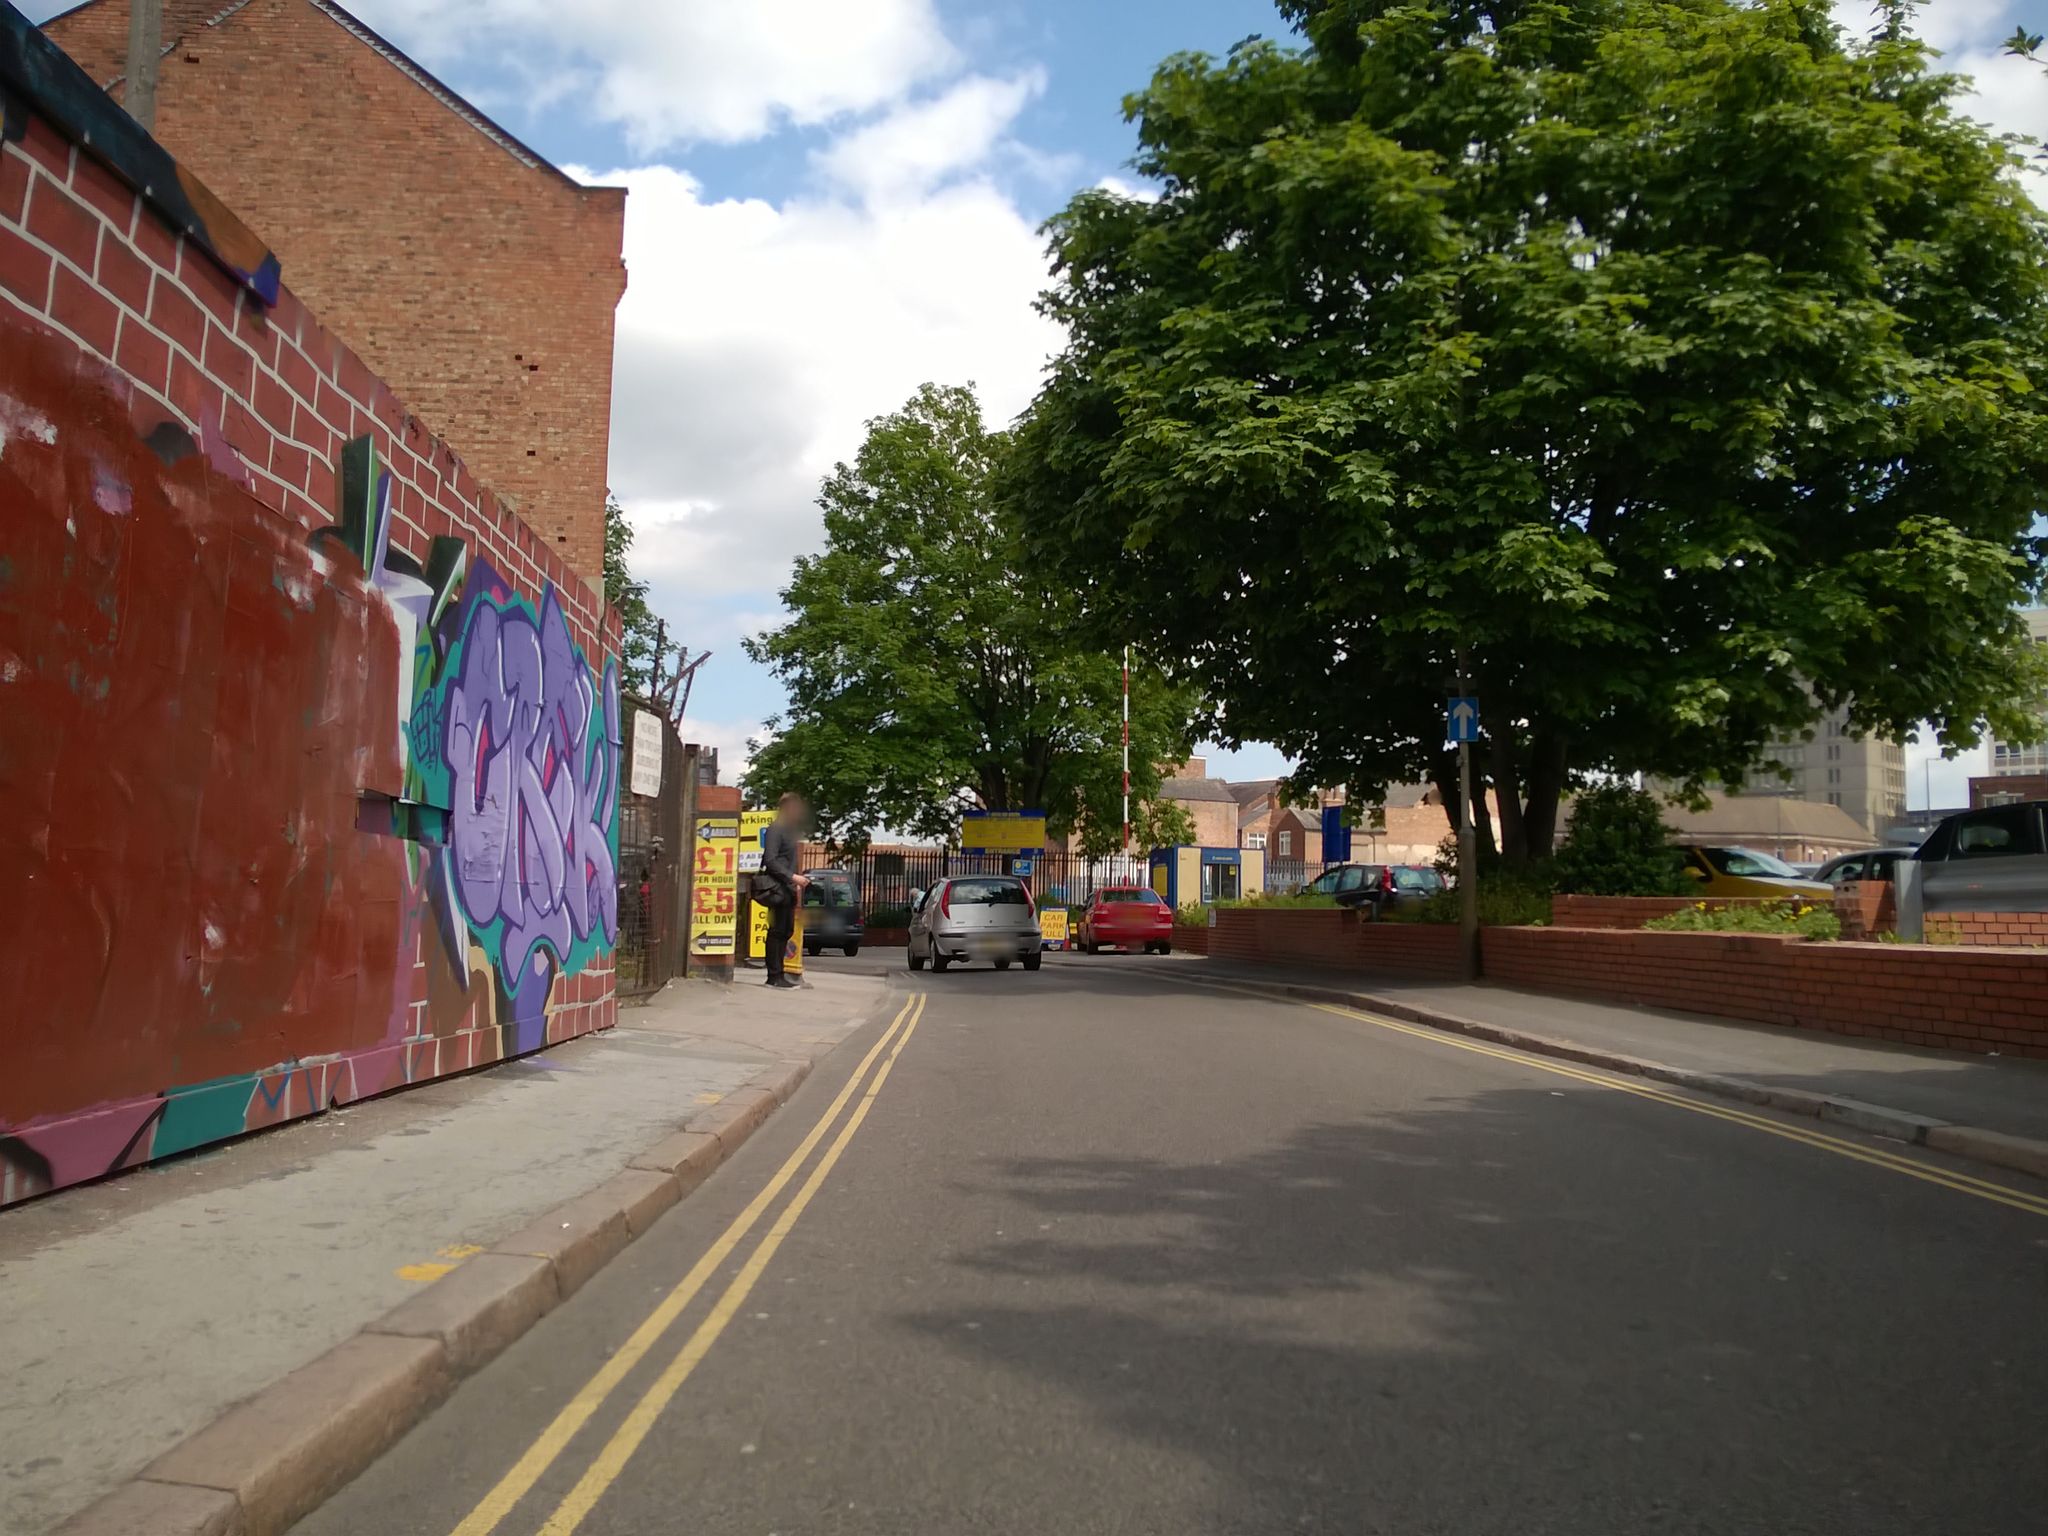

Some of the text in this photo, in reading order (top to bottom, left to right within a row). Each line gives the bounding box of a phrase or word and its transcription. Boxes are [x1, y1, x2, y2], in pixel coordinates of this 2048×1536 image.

[740, 815, 773, 825] arking
[696, 846, 734, 875] £1
[712, 875, 734, 884] HOUR
[695, 886, 734, 914] £5
[691, 915, 734, 925] ALL DAY
